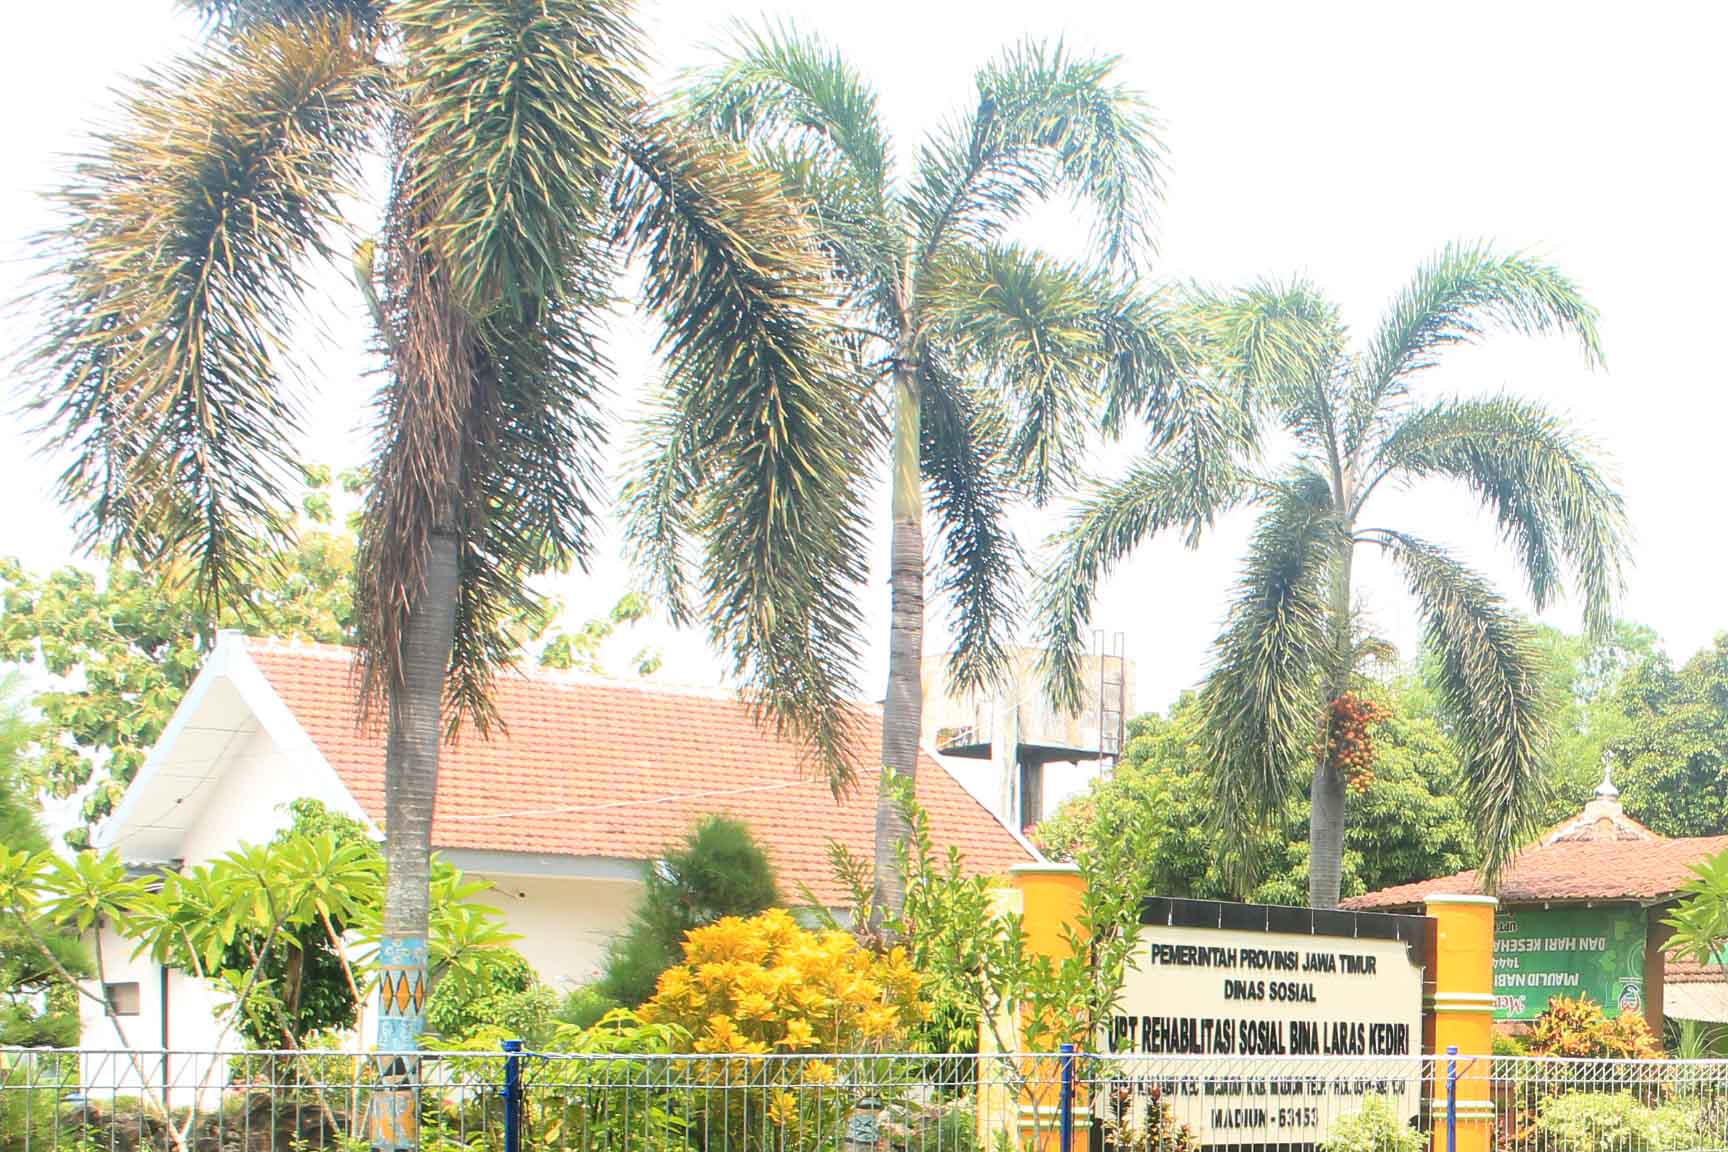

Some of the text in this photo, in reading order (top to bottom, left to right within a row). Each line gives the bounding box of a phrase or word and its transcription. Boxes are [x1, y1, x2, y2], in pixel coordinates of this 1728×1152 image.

[1545, 937, 1576, 952] HARI
[1579, 937, 1606, 952] DAN
[1151, 943, 1377, 975] PEMERINTAH PROVINSI JAWA TIMUR
[1224, 979, 1317, 1002] DINAS SOSIAL
[1528, 973, 1579, 987] MAULID
[1108, 1016, 1410, 1055] UPT REHABILITASI SOSIAL BINA LARAS KEDIRI
[1211, 1108, 1267, 1128] MADIUN
[1279, 1107, 1318, 1128] 63153
